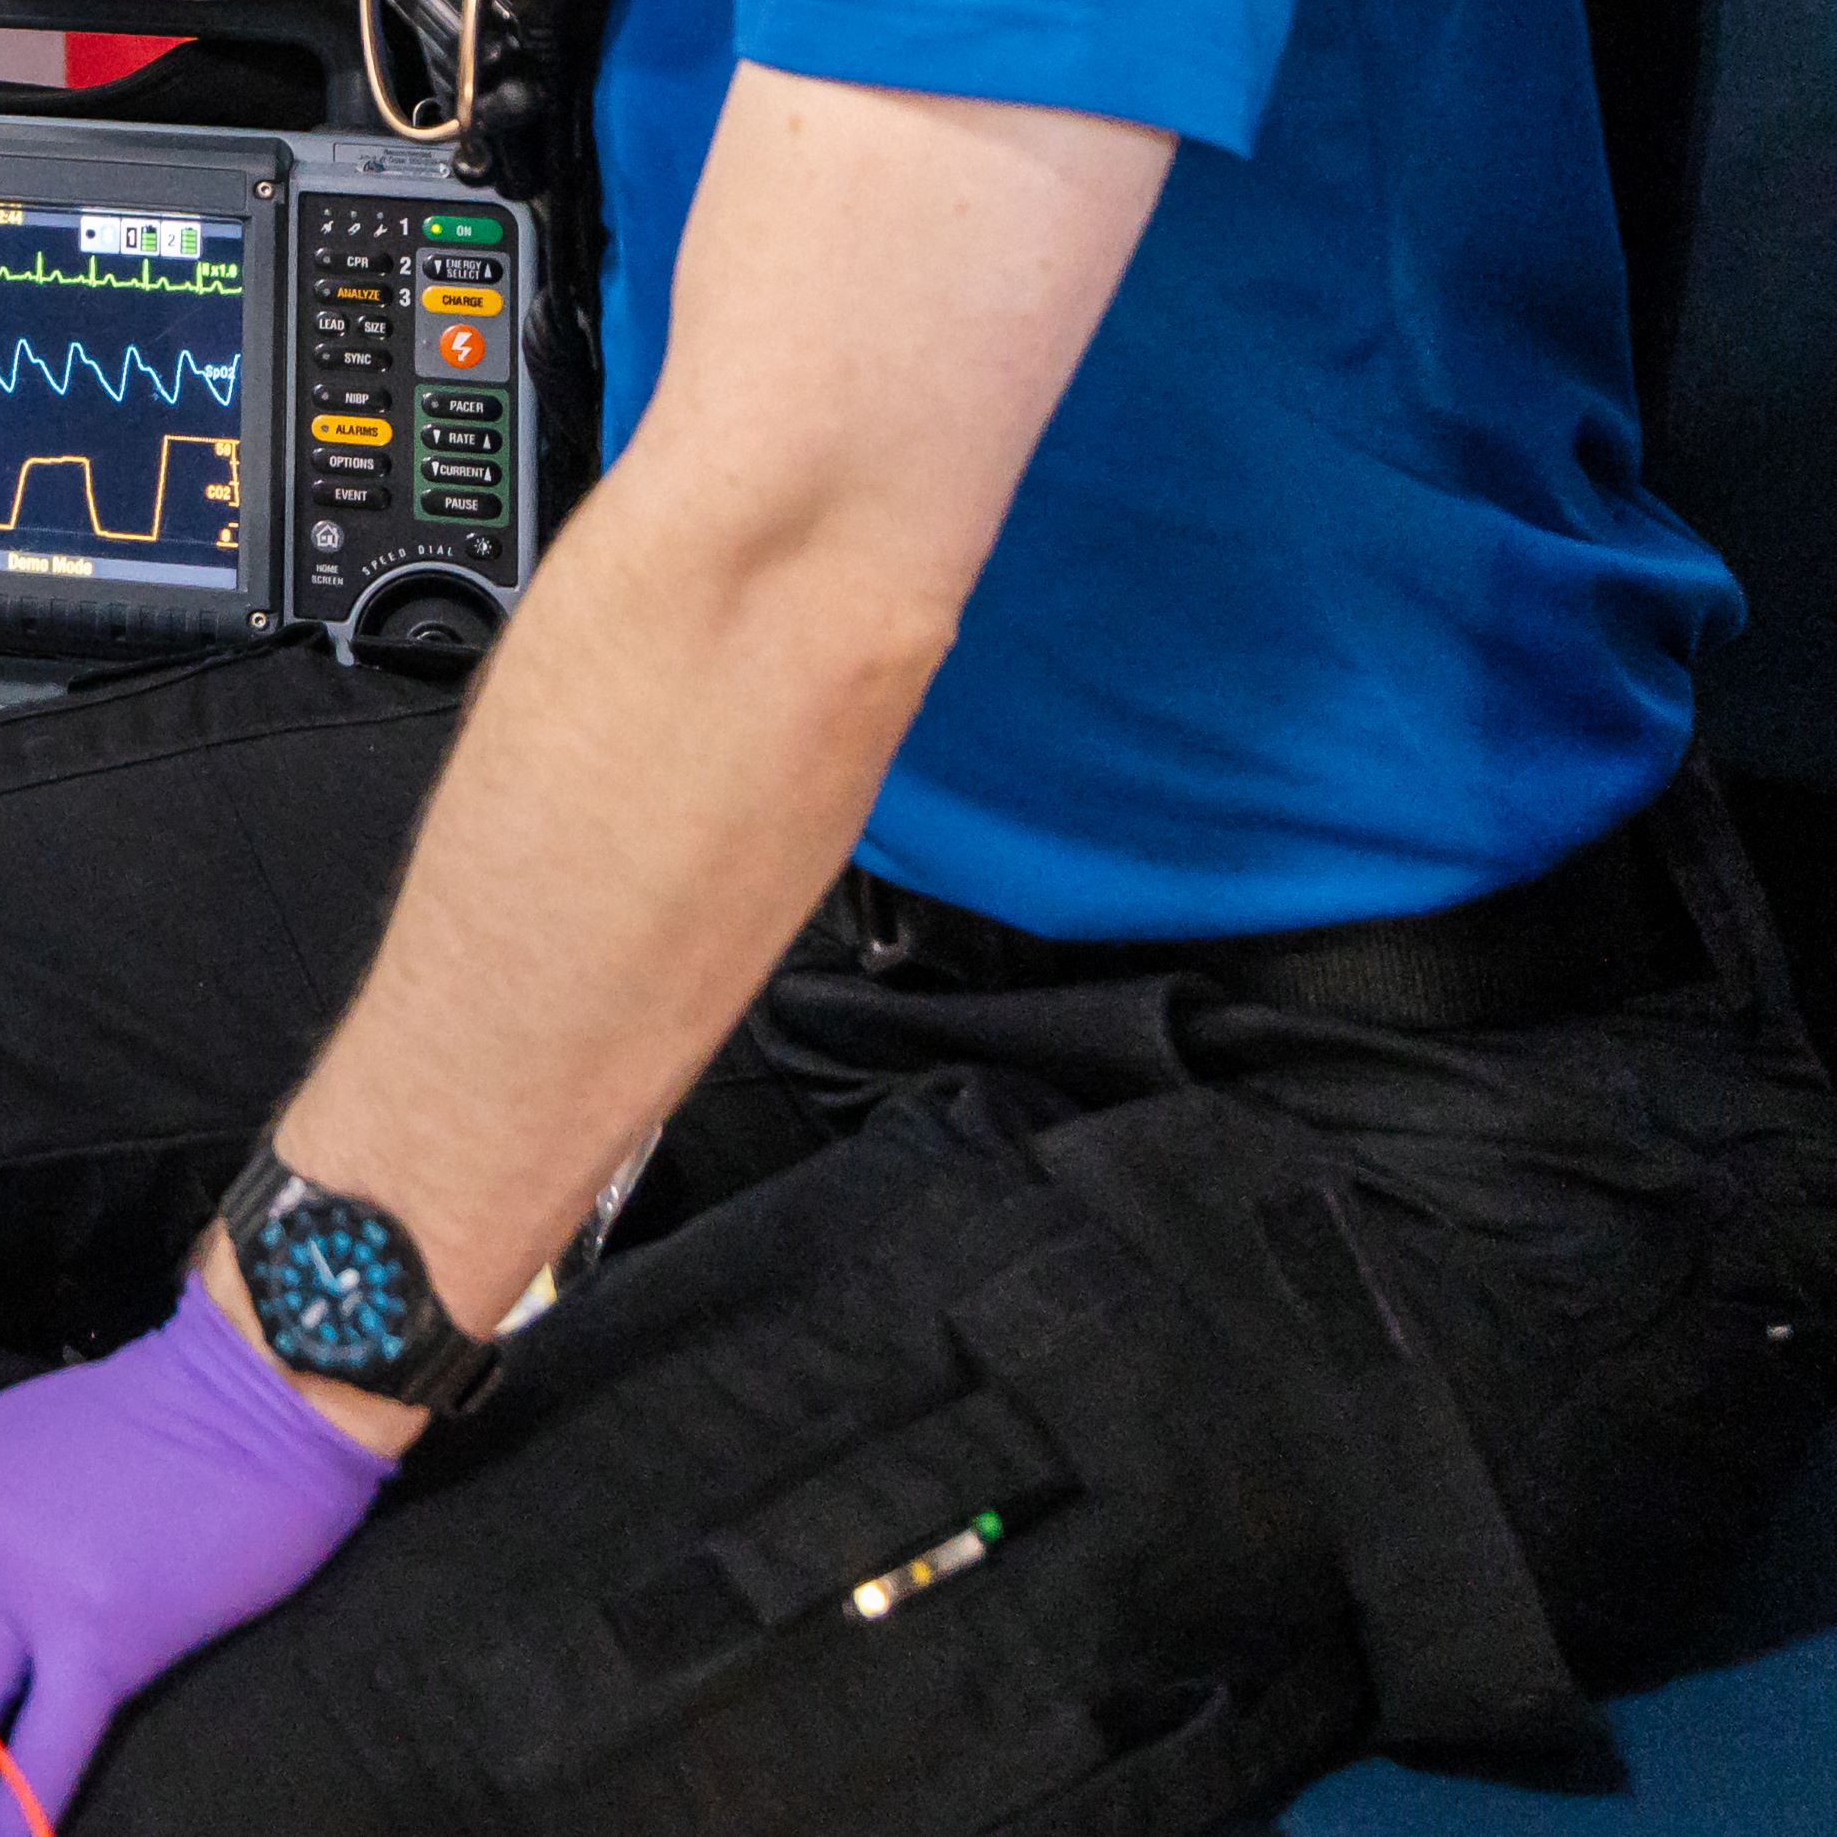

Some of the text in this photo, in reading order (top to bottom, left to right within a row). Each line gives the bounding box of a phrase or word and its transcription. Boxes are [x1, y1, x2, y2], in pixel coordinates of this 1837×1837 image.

[399, 217, 409, 236] 1
[456, 225, 472, 237] ON
[346, 256, 369, 269] CPR
[399, 256, 412, 275] 2
[446, 258, 482, 270] ENERGY
[446, 267, 480, 280] SELECT
[337, 287, 380, 301] ANALYZE
[399, 288, 411, 307] 3
[442, 294, 484, 308] CHARGE
[319, 318, 345, 331] LEAD
[364, 321, 386, 334] SIZE
[344, 352, 372, 364] SYNC
[345, 392, 370, 406] NIBP
[449, 399, 484, 414] PACER
[335, 422, 379, 438] ALARMS
[449, 431, 476, 445] RATE
[329, 455, 375, 471] OPTIONS
[439, 466, 485, 479] CURRENT
[206, 484, 232, 501] CO2
[335, 487, 368, 502] EVENT
[445, 497, 478, 511] PAUSE
[7, 552, 93, 575] Demo Mode
[362, 544, 454, 577] SPEED DIAL
[316, 564, 339, 574] HOME
[311, 574, 344, 586] SCREEN
